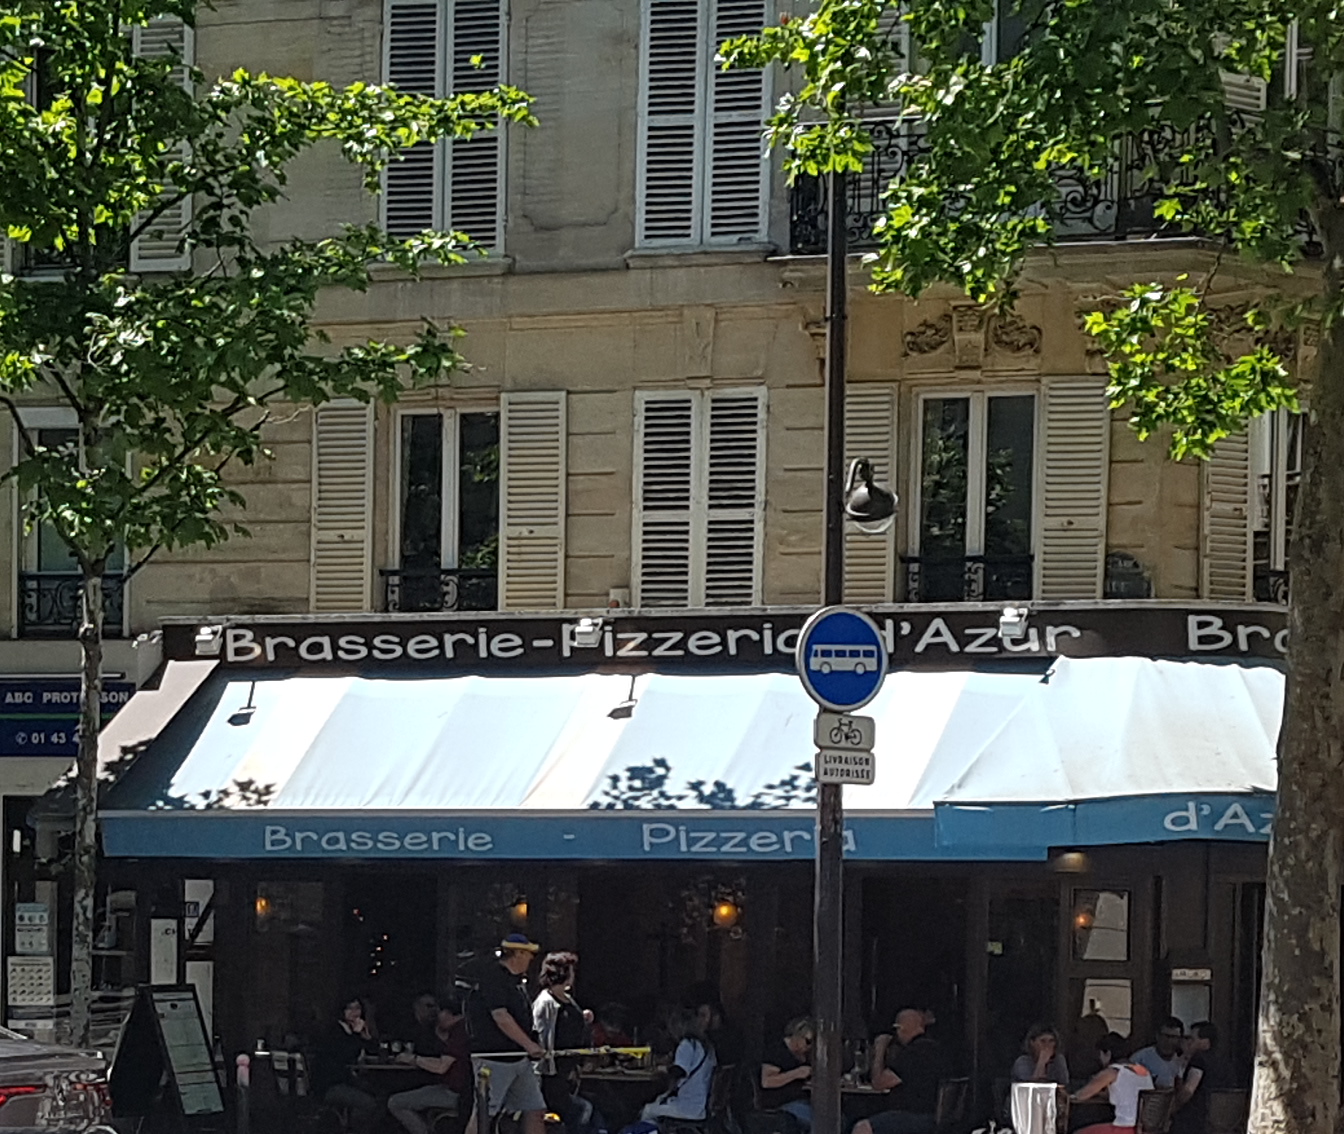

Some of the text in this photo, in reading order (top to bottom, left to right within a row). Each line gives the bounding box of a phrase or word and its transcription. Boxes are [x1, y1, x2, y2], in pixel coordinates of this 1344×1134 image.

[5, 692, 33, 704] ABC
[31, 732, 45, 744] 01
[51, 732, 67, 744] 43
[824, 754, 870, 766] LIVRAISON
[264, 825, 494, 851] Brasserie
